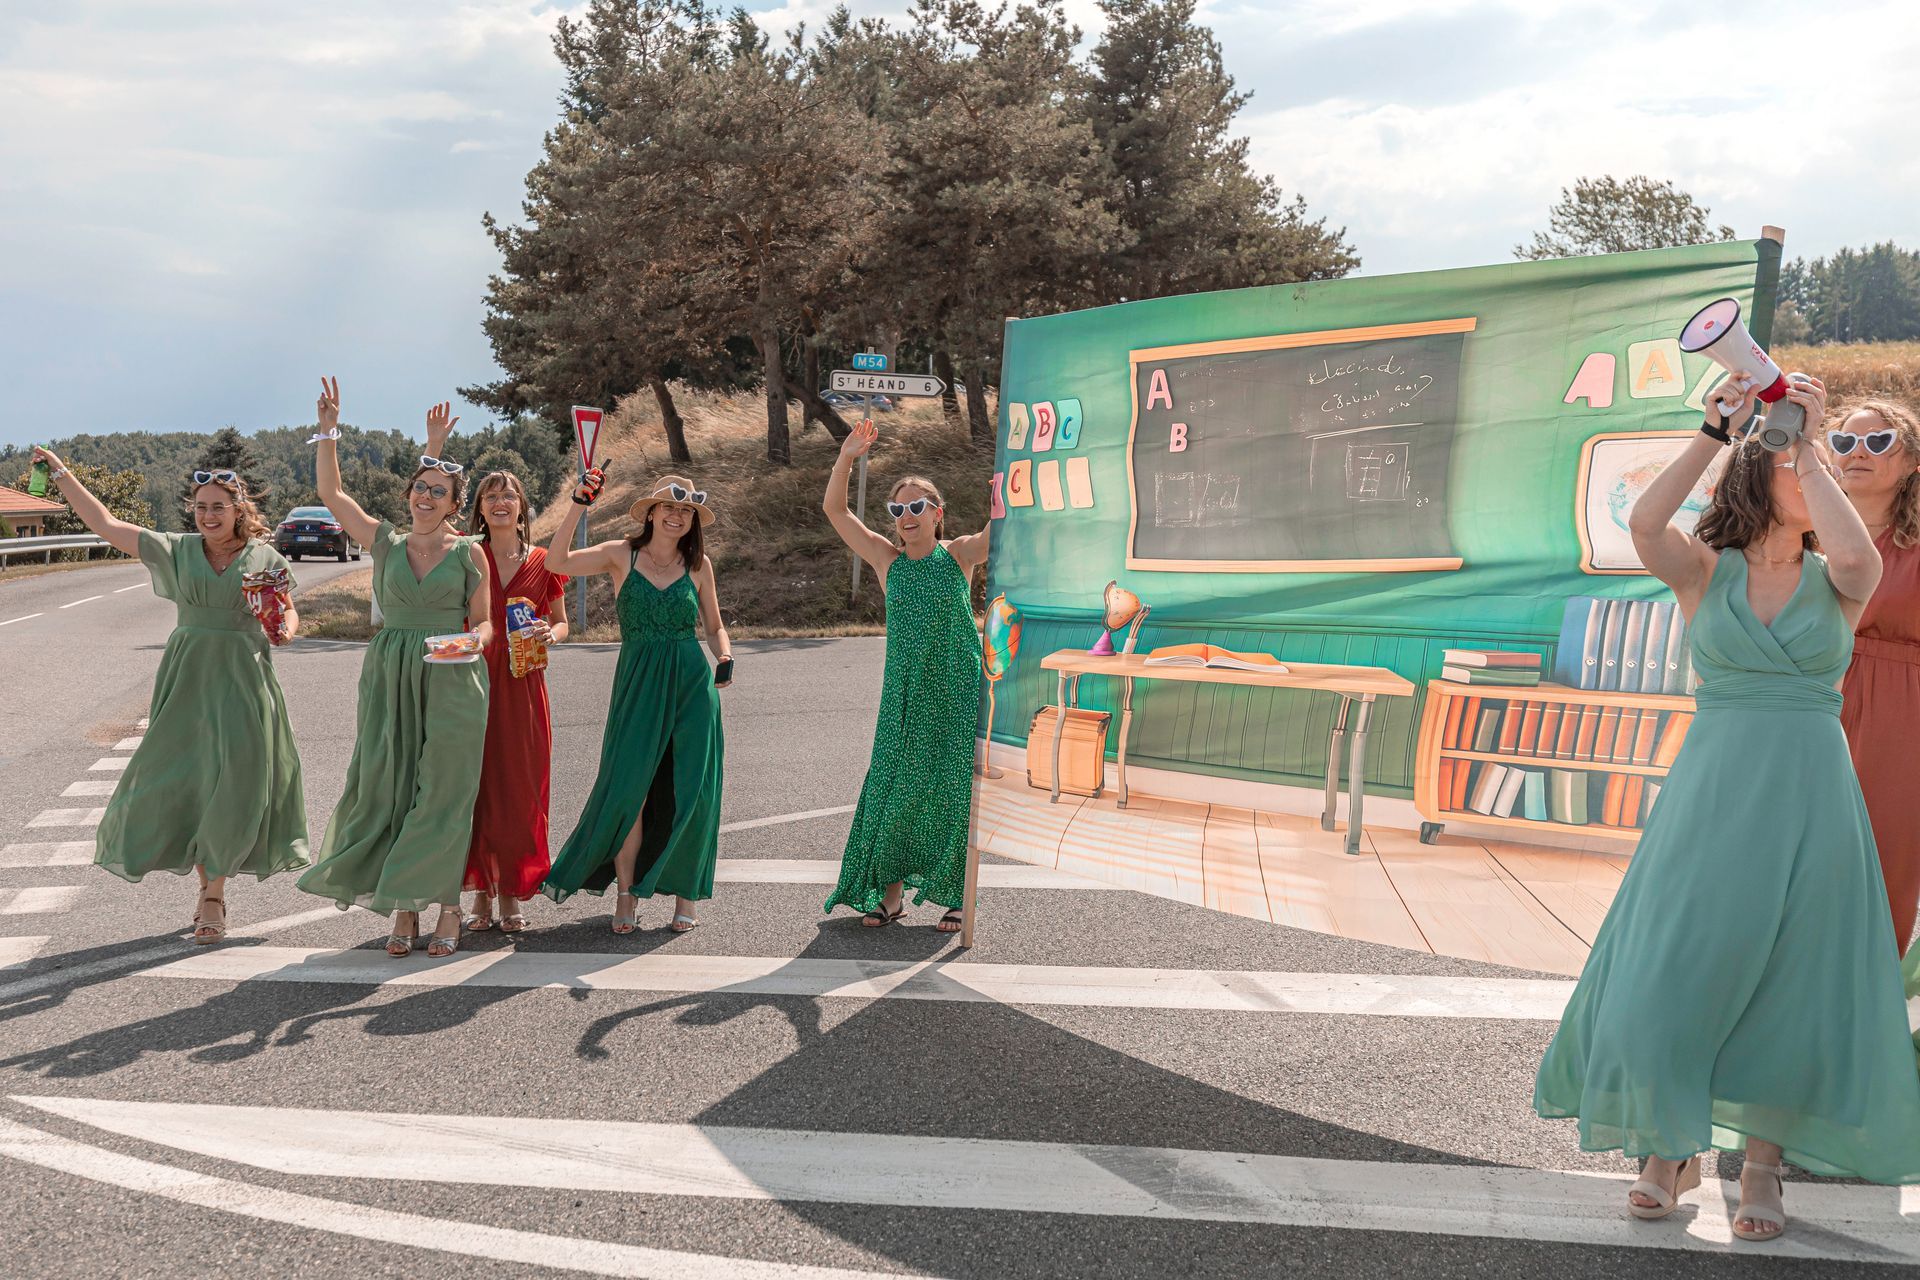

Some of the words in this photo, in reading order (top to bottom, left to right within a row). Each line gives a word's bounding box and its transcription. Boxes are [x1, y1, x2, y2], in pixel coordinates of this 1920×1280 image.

[858, 358, 883, 369] M54
[857, 376, 906, 390] HÉAND
[924, 381, 932, 392] 6
[1146, 369, 1173, 411] A
[1170, 422, 1189, 453] B
